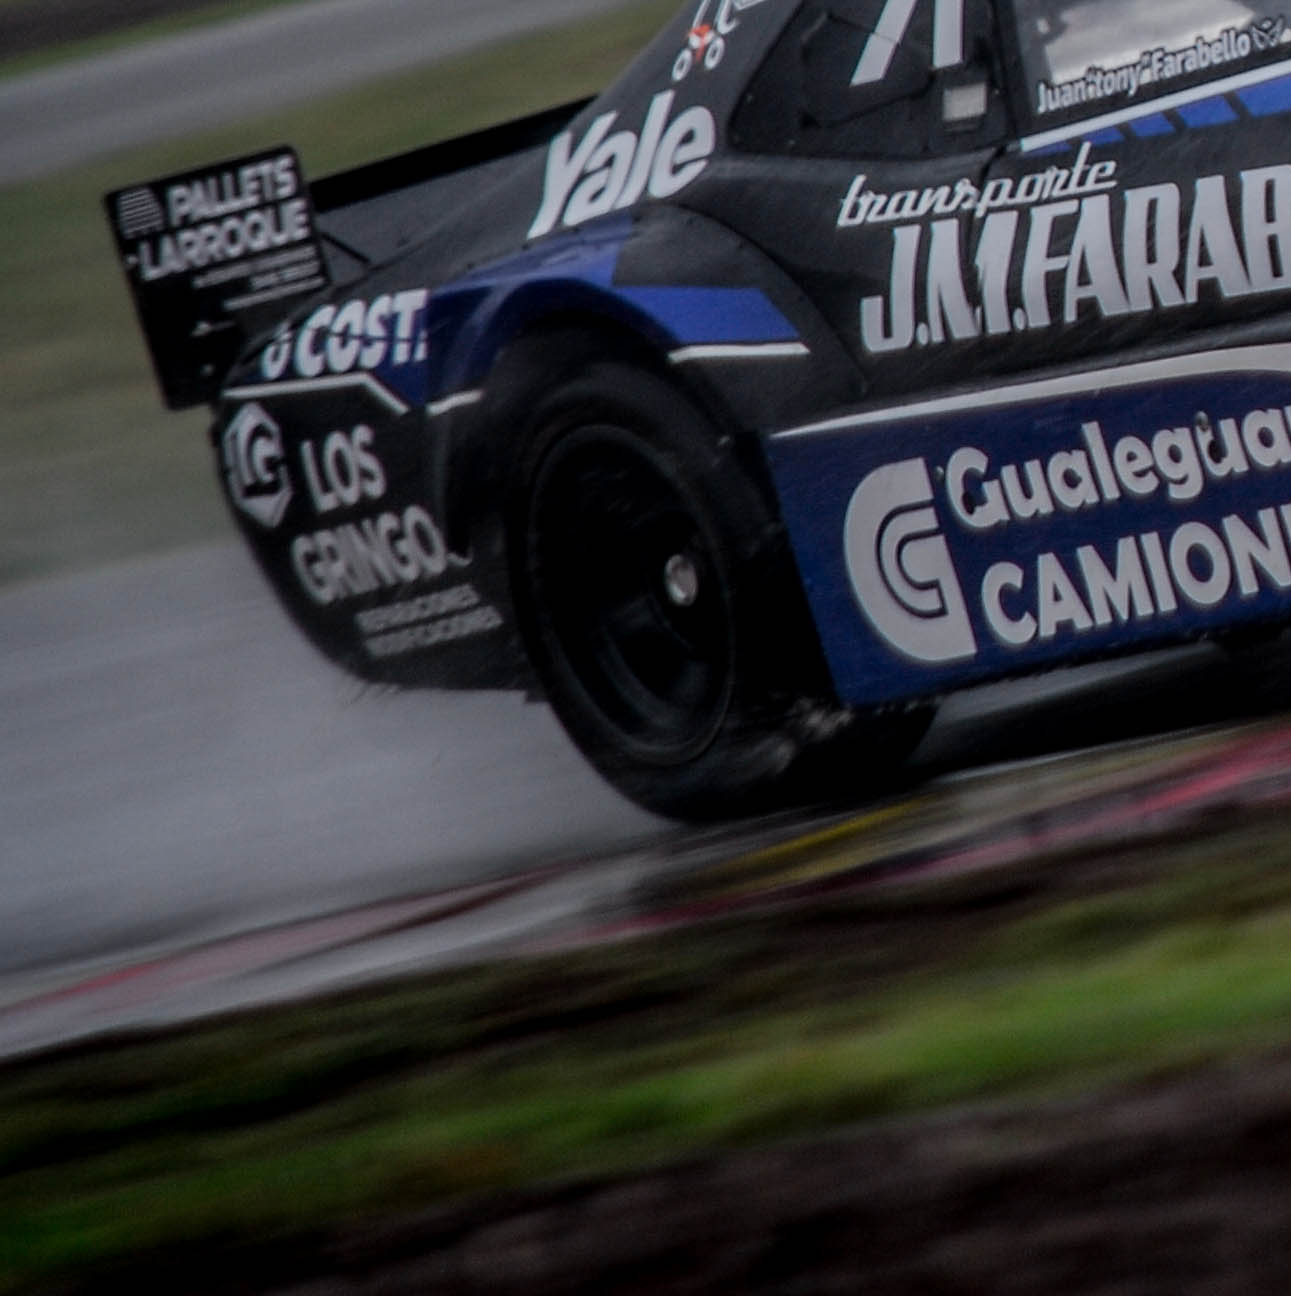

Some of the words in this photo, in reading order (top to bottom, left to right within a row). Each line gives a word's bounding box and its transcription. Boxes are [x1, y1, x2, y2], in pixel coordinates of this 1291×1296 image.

[166, 153, 297, 227] PALLETS
[527, 89, 716, 240] Yale
[837, 141, 1118, 227] transporte
[139, 196, 312, 280] LARROQUE
[300, 424, 388, 513] LOS
[290, 504, 473, 605] GRINGO
